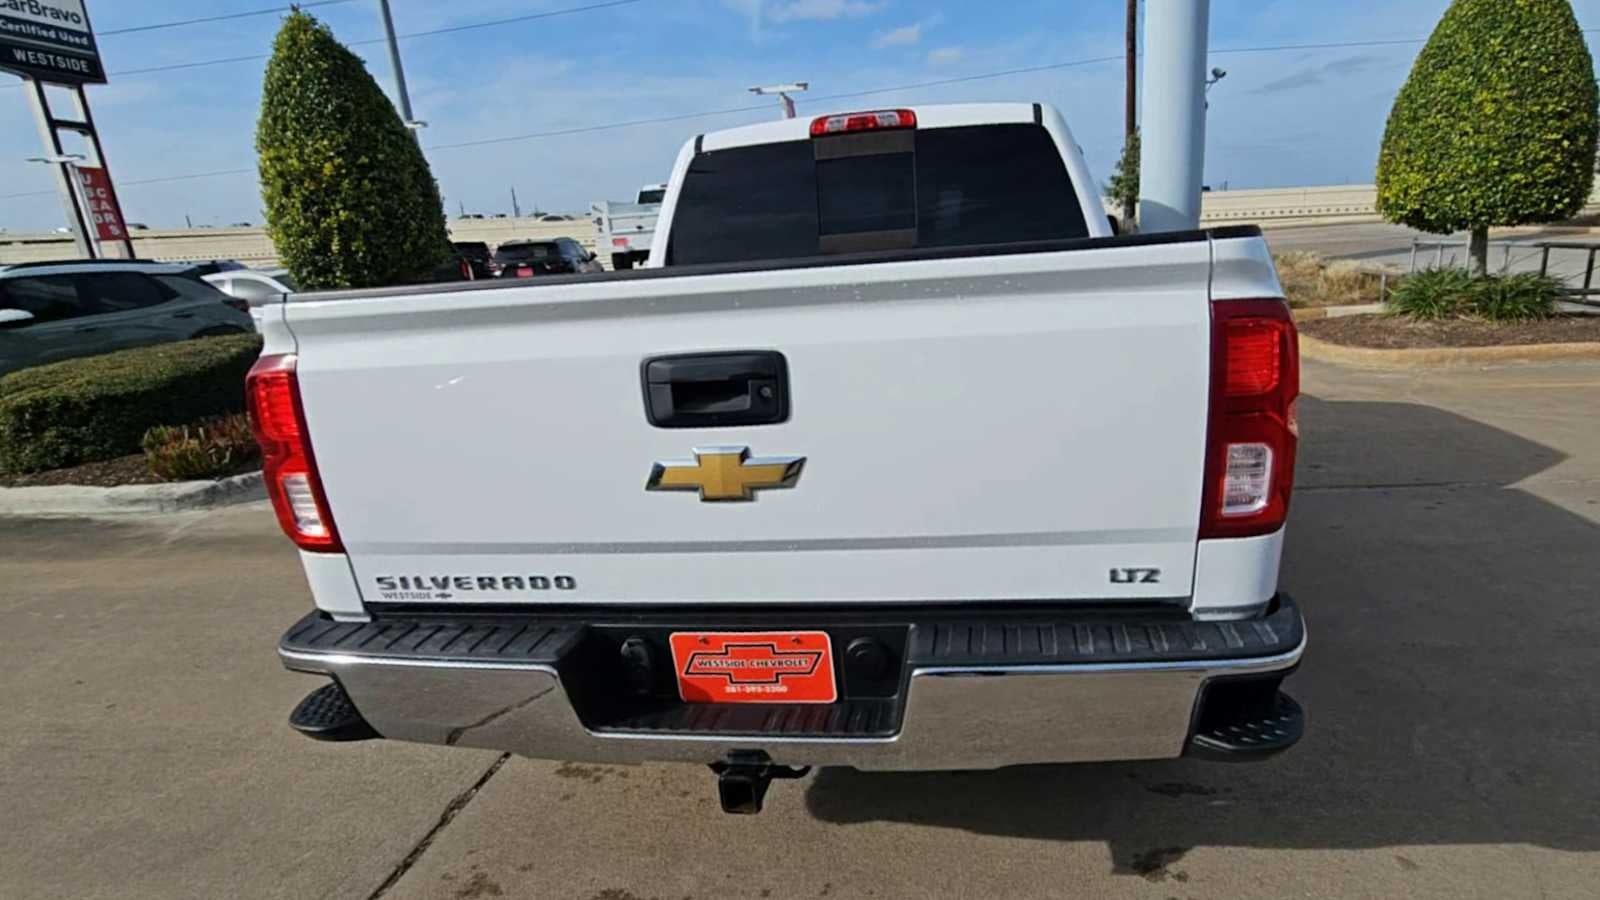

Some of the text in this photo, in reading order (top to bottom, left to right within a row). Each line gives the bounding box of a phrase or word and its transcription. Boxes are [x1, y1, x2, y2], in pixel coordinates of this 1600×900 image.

[0, 21, 89, 46] Certified Used
[12, 48, 90, 73] WESTSIDE
[96, 187, 120, 236] CARS
[376, 575, 577, 590] SILVERADO
[1109, 568, 1161, 583] LTZ
[382, 592, 432, 600] WESTSIDE
[698, 658, 808, 668] WESTSIDE CHEVROLET
